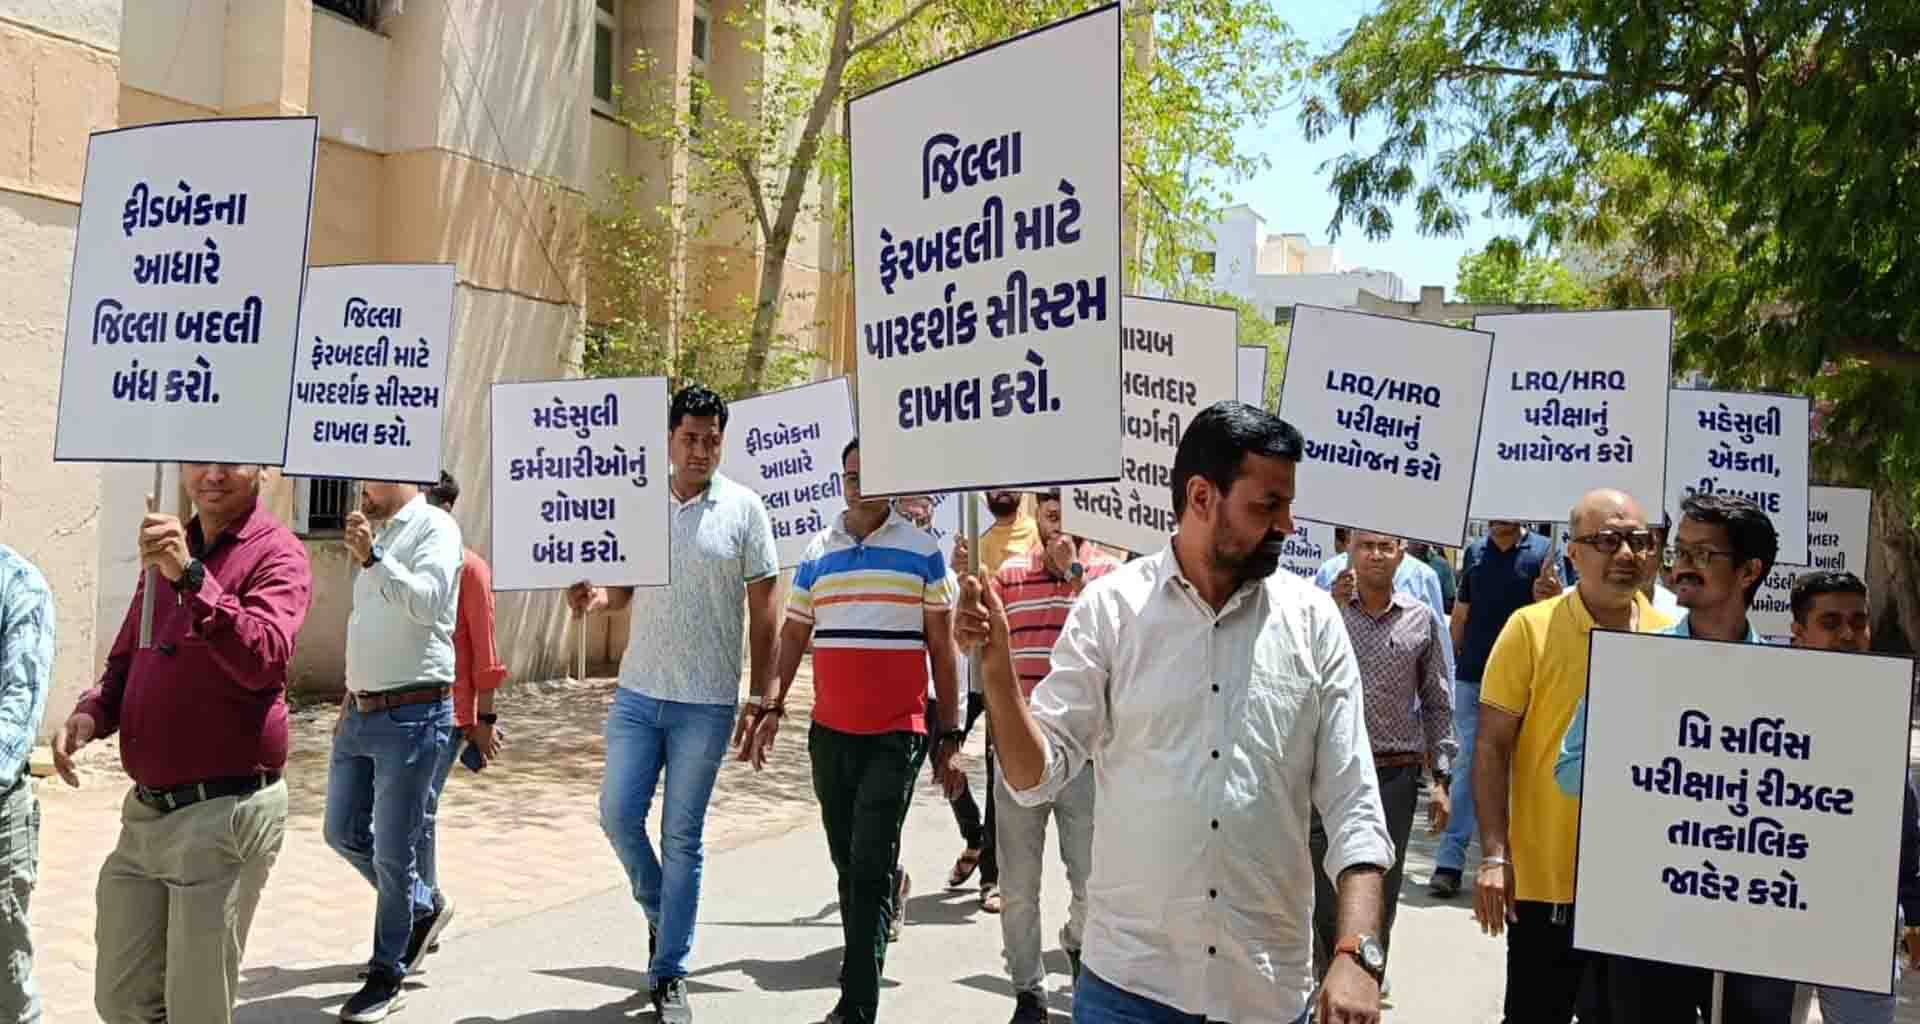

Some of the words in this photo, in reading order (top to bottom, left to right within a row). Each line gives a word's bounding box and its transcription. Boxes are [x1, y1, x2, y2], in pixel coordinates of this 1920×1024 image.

[923, 131, 1022, 199] જિલ્લા
[123, 180, 247, 236] ફીડબેકના
[880, 195, 1003, 294] ફેરબદલી
[1014, 178, 1082, 250] માટે
[134, 237, 220, 284] આધારે
[93, 298, 168, 344] જિલ્લા
[175, 296, 262, 343] બદલી
[344, 297, 401, 328] જિલ્લા
[865, 282, 978, 359] પારદર્શક
[986, 270, 1107, 339] સીસ્ટમ
[312, 335, 389, 370] ફેરબદલી
[394, 337, 430, 368] માટે
[1123, 328, 1173, 356] ાયબ
[113, 359, 158, 401] બંધ
[165, 355, 219, 403] કરો.
[297, 373, 370, 404] પારદર્શક
[375, 376, 439, 408] સીસ્ટમ
[899, 378, 981, 429] દાખલ
[991, 349, 1061, 417] કરો.
[1326, 370, 1441, 408] LRQ/HRQ
[1511, 370, 1626, 393] LRQ/HRQ
[313, 420, 368, 443] દાખલ
[373, 415, 411, 447] કરો.
[533, 393, 619, 439] મહેસુલી
[1336, 404, 1421, 450] પરીક્ષાનું
[1525, 398, 1609, 437] પરીક્ષાનું
[1698, 403, 1781, 444] મહેસુલી
[745, 422, 821, 456] ફીડબેકના
[1497, 436, 1591, 463] આયોજન
[1597, 435, 1634, 463] કરો
[510, 444, 648, 487] કર્મચારીઓનું
[760, 450, 813, 480] આધારે
[1305, 440, 1398, 475] આયોજન
[1404, 453, 1441, 481] કરો
[1708, 441, 1781, 478] એકતા,
[541, 490, 615, 522] શોષણ
[794, 472, 841, 504] બદલી
[1072, 485, 1123, 520] સત્વરે
[795, 510, 828, 536] કરો.
[533, 534, 574, 563] બંધ
[580, 530, 626, 563] કરો.
[1678, 710, 1711, 750] પ્રિ
[1720, 717, 1811, 760] સર્વિસ
[1631, 757, 1750, 817] પરીક્ષાનું
[1756, 768, 1854, 815] રીઝલ્ટ
[1667, 817, 1810, 860] તાત્કાલિક
[1661, 860, 1740, 902] જાહેર
[1747, 869, 1808, 911] કરો.
